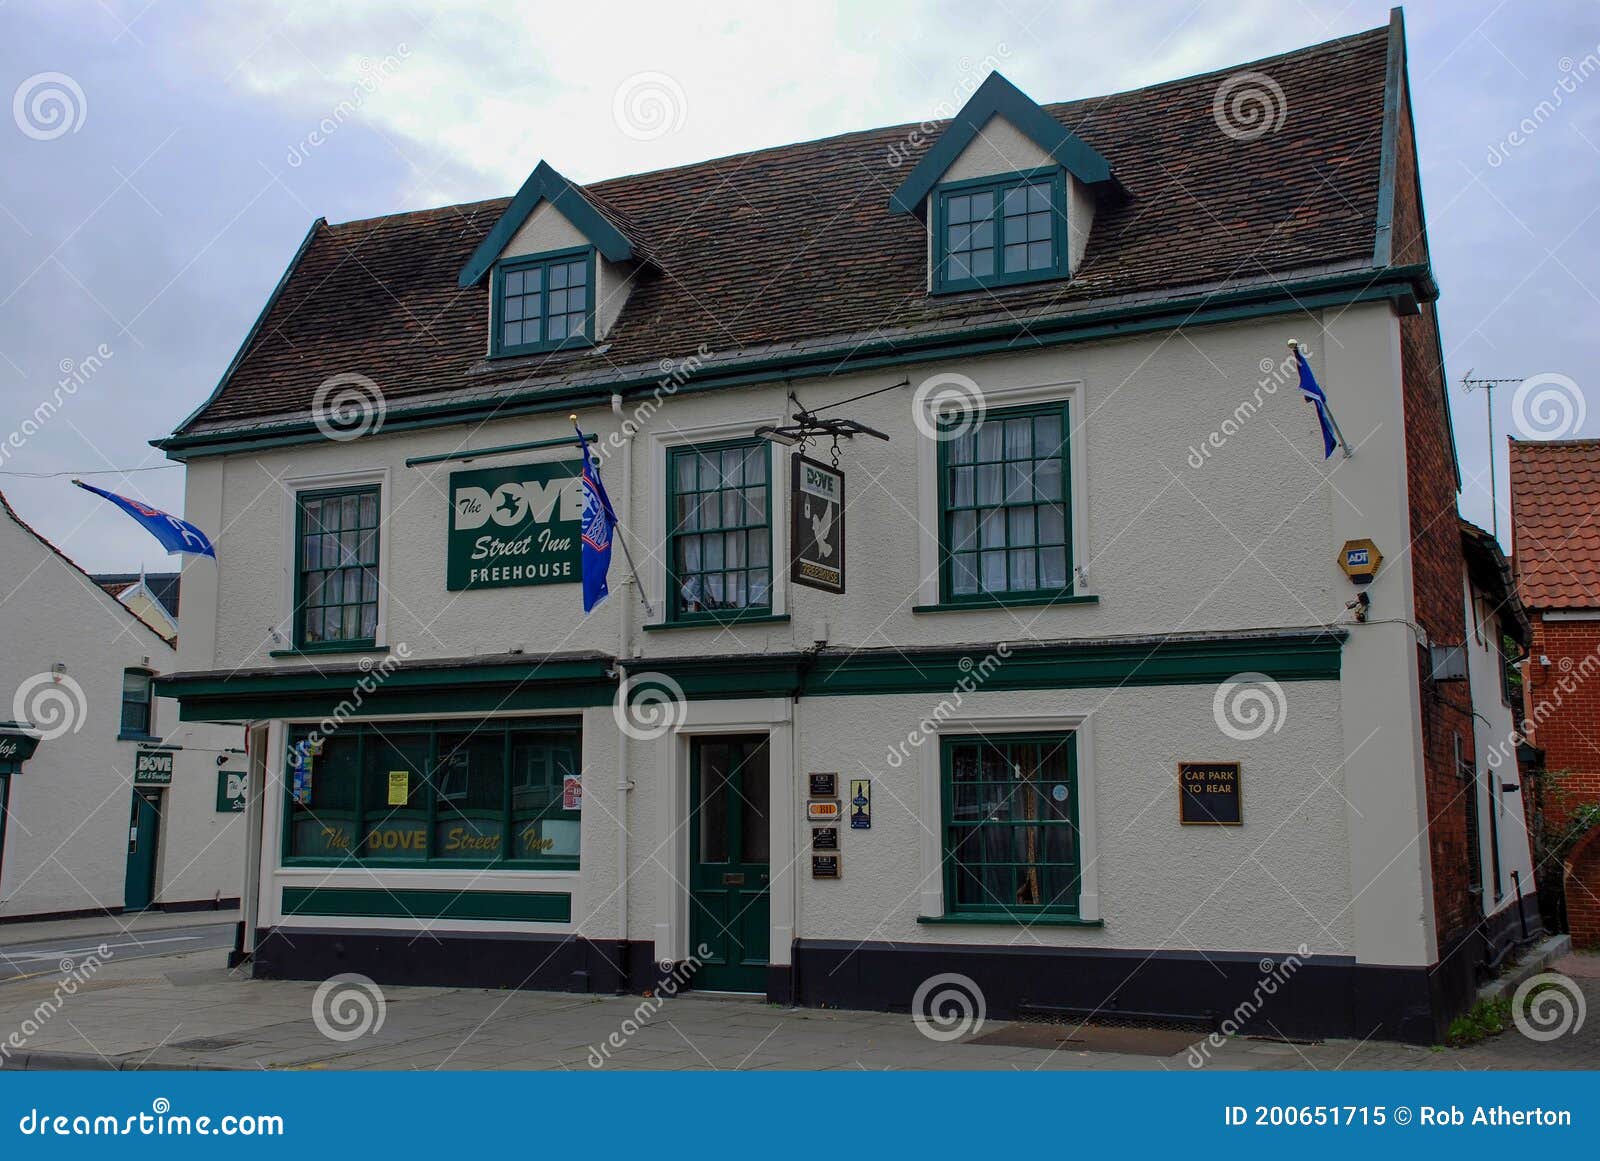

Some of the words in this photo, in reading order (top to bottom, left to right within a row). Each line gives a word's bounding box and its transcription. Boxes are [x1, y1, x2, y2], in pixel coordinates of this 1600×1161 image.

[806, 466, 834, 493] DOVE
[455, 476, 583, 531] DOVE
[459, 497, 482, 516] The
[471, 535, 532, 560] Street
[537, 528, 572, 553] Inn
[1350, 552, 1368, 562] ADT
[470, 561, 572, 583] FREEHOUSE
[0, 739, 17, 758] hop
[138, 756, 172, 772] DOVE
[1185, 771, 1205, 780] CAR
[1208, 771, 1234, 780] PARK
[1188, 784, 1202, 793] TO
[1206, 784, 1232, 793] REAR
[321, 826, 351, 849] The
[368, 830, 427, 849] DOVE
[446, 827, 500, 851] Street
[523, 828, 554, 851] Inn
